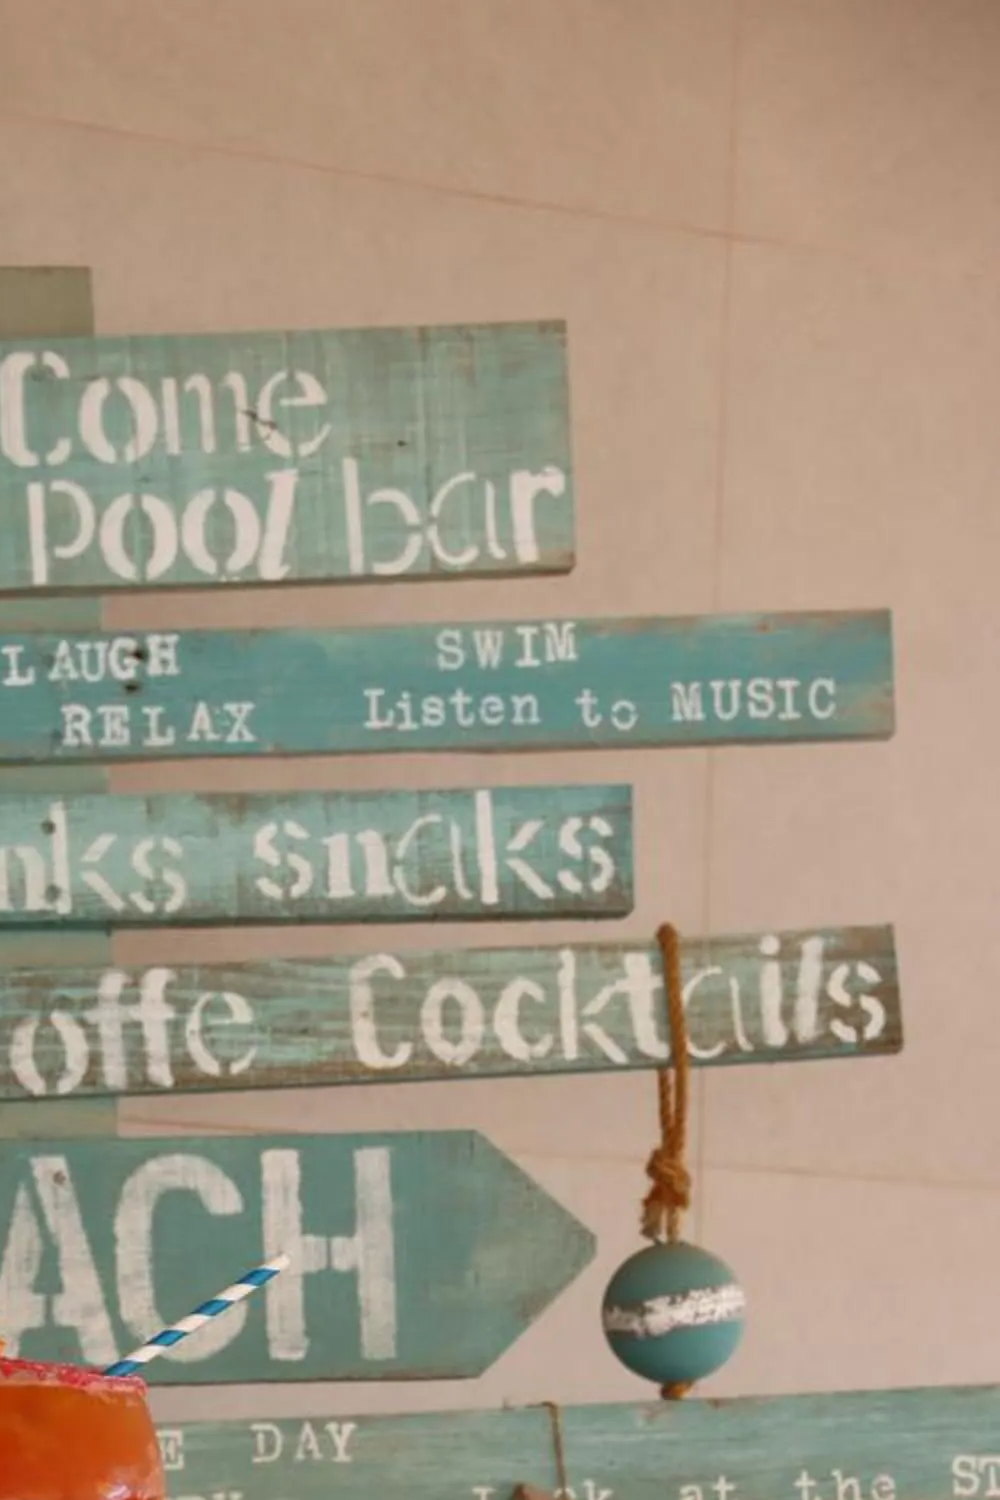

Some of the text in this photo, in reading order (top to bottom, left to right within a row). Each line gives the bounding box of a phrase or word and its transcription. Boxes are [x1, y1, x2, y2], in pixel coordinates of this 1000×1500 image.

[345, 457, 567, 577] bar
[0, 633, 181, 687] LAUGH
[436, 621, 579, 672] SWIM
[60, 702, 257, 748] RELAX
[363, 676, 838, 734] Listen to MUSIC
[249, 1419, 357, 1463] DAY
[951, 1453, 1000, 1497] ST
